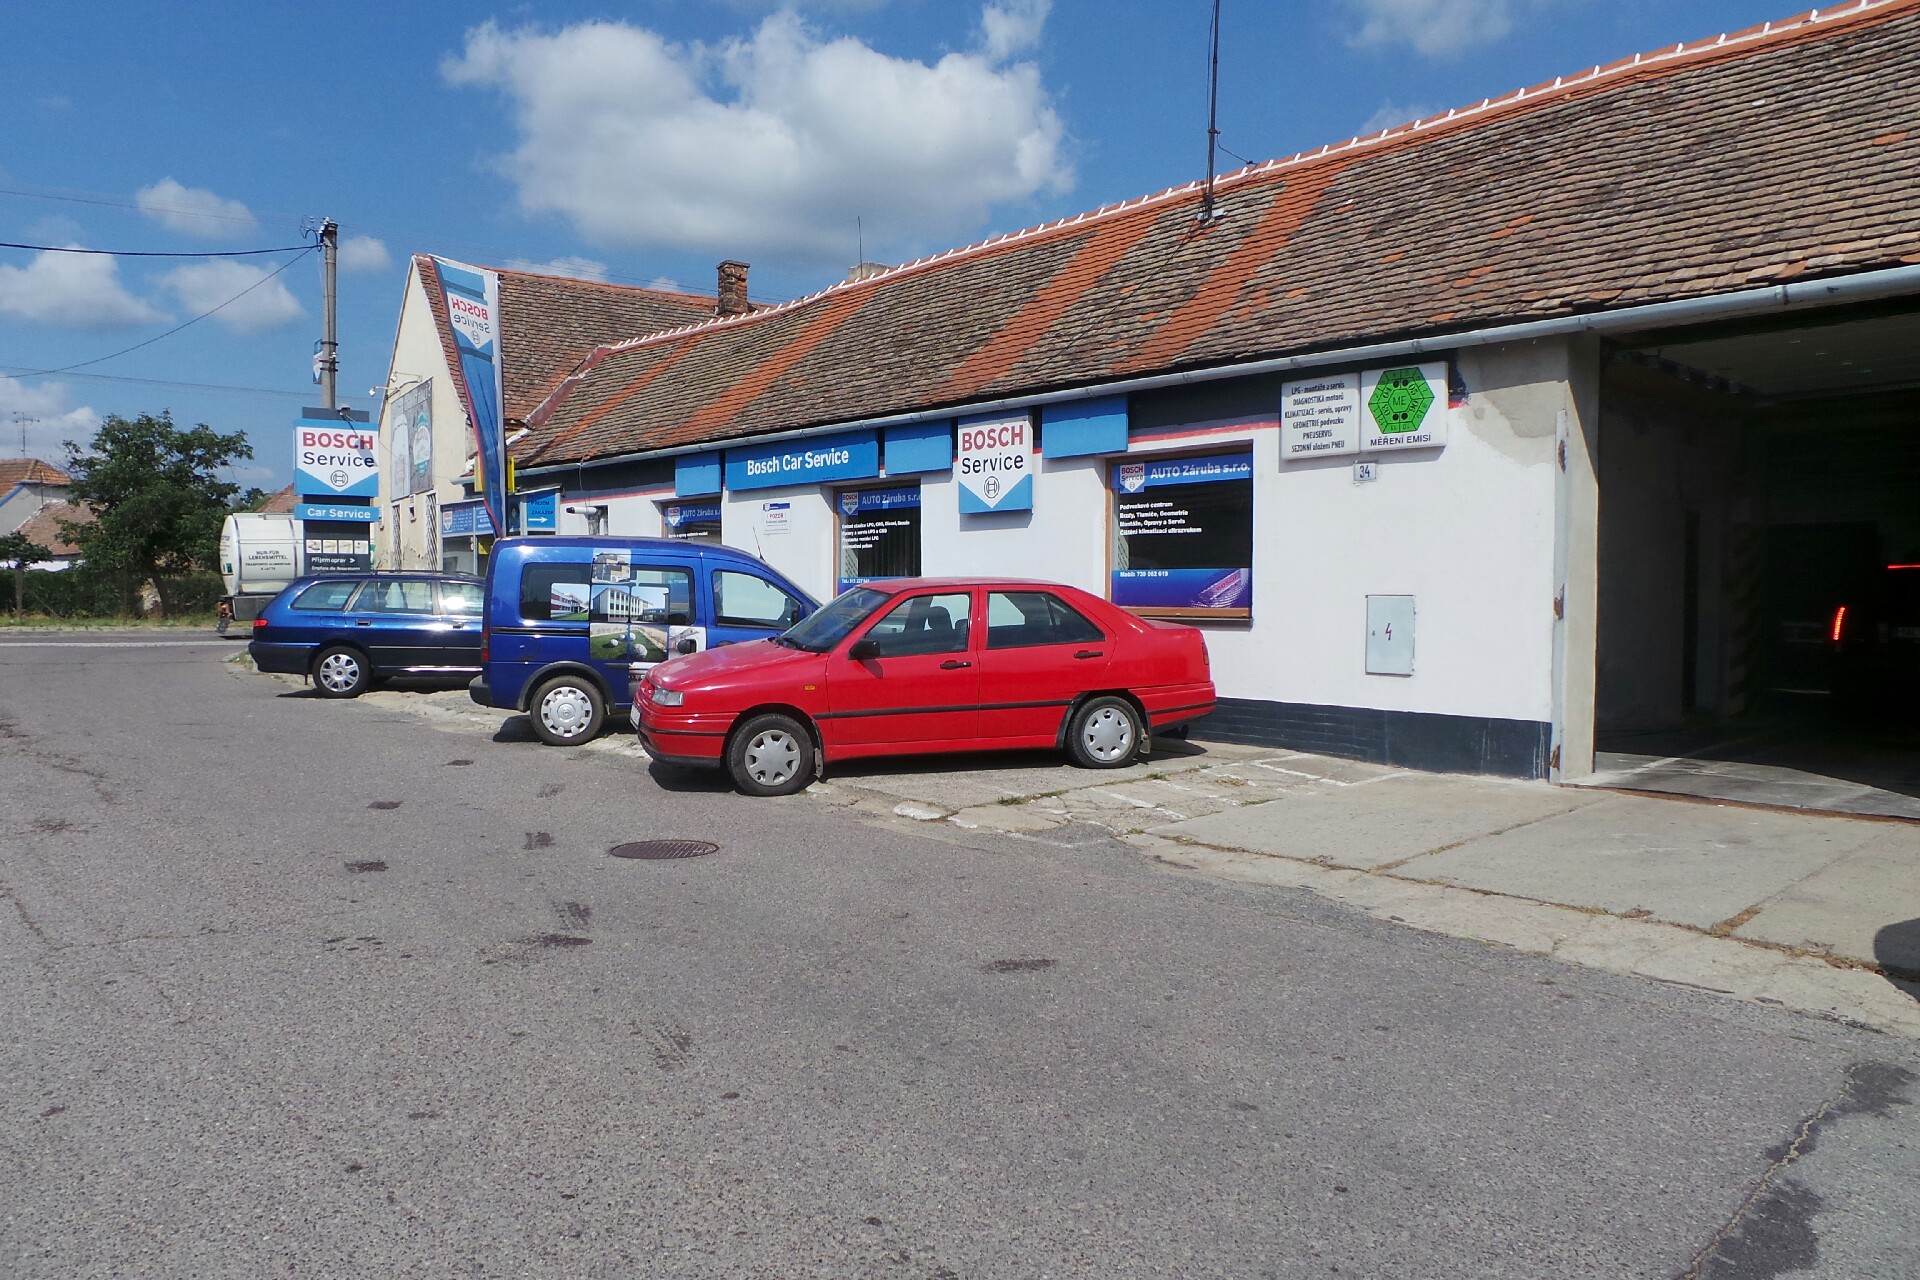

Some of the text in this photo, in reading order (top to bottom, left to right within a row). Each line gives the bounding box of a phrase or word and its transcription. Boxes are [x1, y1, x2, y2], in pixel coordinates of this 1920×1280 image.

[1291, 386, 1301, 395] LPG
[1304, 384, 1325, 393] montáže
[1330, 381, 1345, 389] servis
[1293, 392, 1344, 406] DIAGNOSTIKA motorů
[1392, 395, 1407, 406] ME
[1284, 407, 1314, 418] KLIMATIZACE
[1317, 405, 1333, 415] servis,
[1334, 404, 1352, 413] opravy
[1292, 416, 1344, 429] GEOMETRIE podvozku
[302, 432, 374, 450] BOSCH
[962, 424, 1024, 452] BOSCH
[1302, 429, 1333, 440] PNEUSERVIS
[1370, 432, 1431, 446] MĚŘENÍ EMISÍ
[1313, 442, 1331, 451] uložení
[1331, 440, 1345, 448] PNEU
[302, 452, 375, 467] Service
[747, 448, 849, 476] Bosch Car Service
[961, 452, 1024, 474] Service
[1121, 465, 1144, 474] BOSCH
[1150, 462, 1251, 479] AUTO Záruba s.r.o.
[1359, 465, 1371, 478] 34
[1121, 473, 1144, 482] Service
[842, 493, 858, 501] BOSCH
[861, 495, 881, 505] AUTO
[881, 493, 906, 503] Záruba
[1119, 502, 1149, 510] Podvozkové
[307, 508, 371, 519] Car Service
[682, 509, 696, 518] AUTO
[696, 508, 714, 517] Záruba
[1159, 509, 1189, 517] Geometrie
